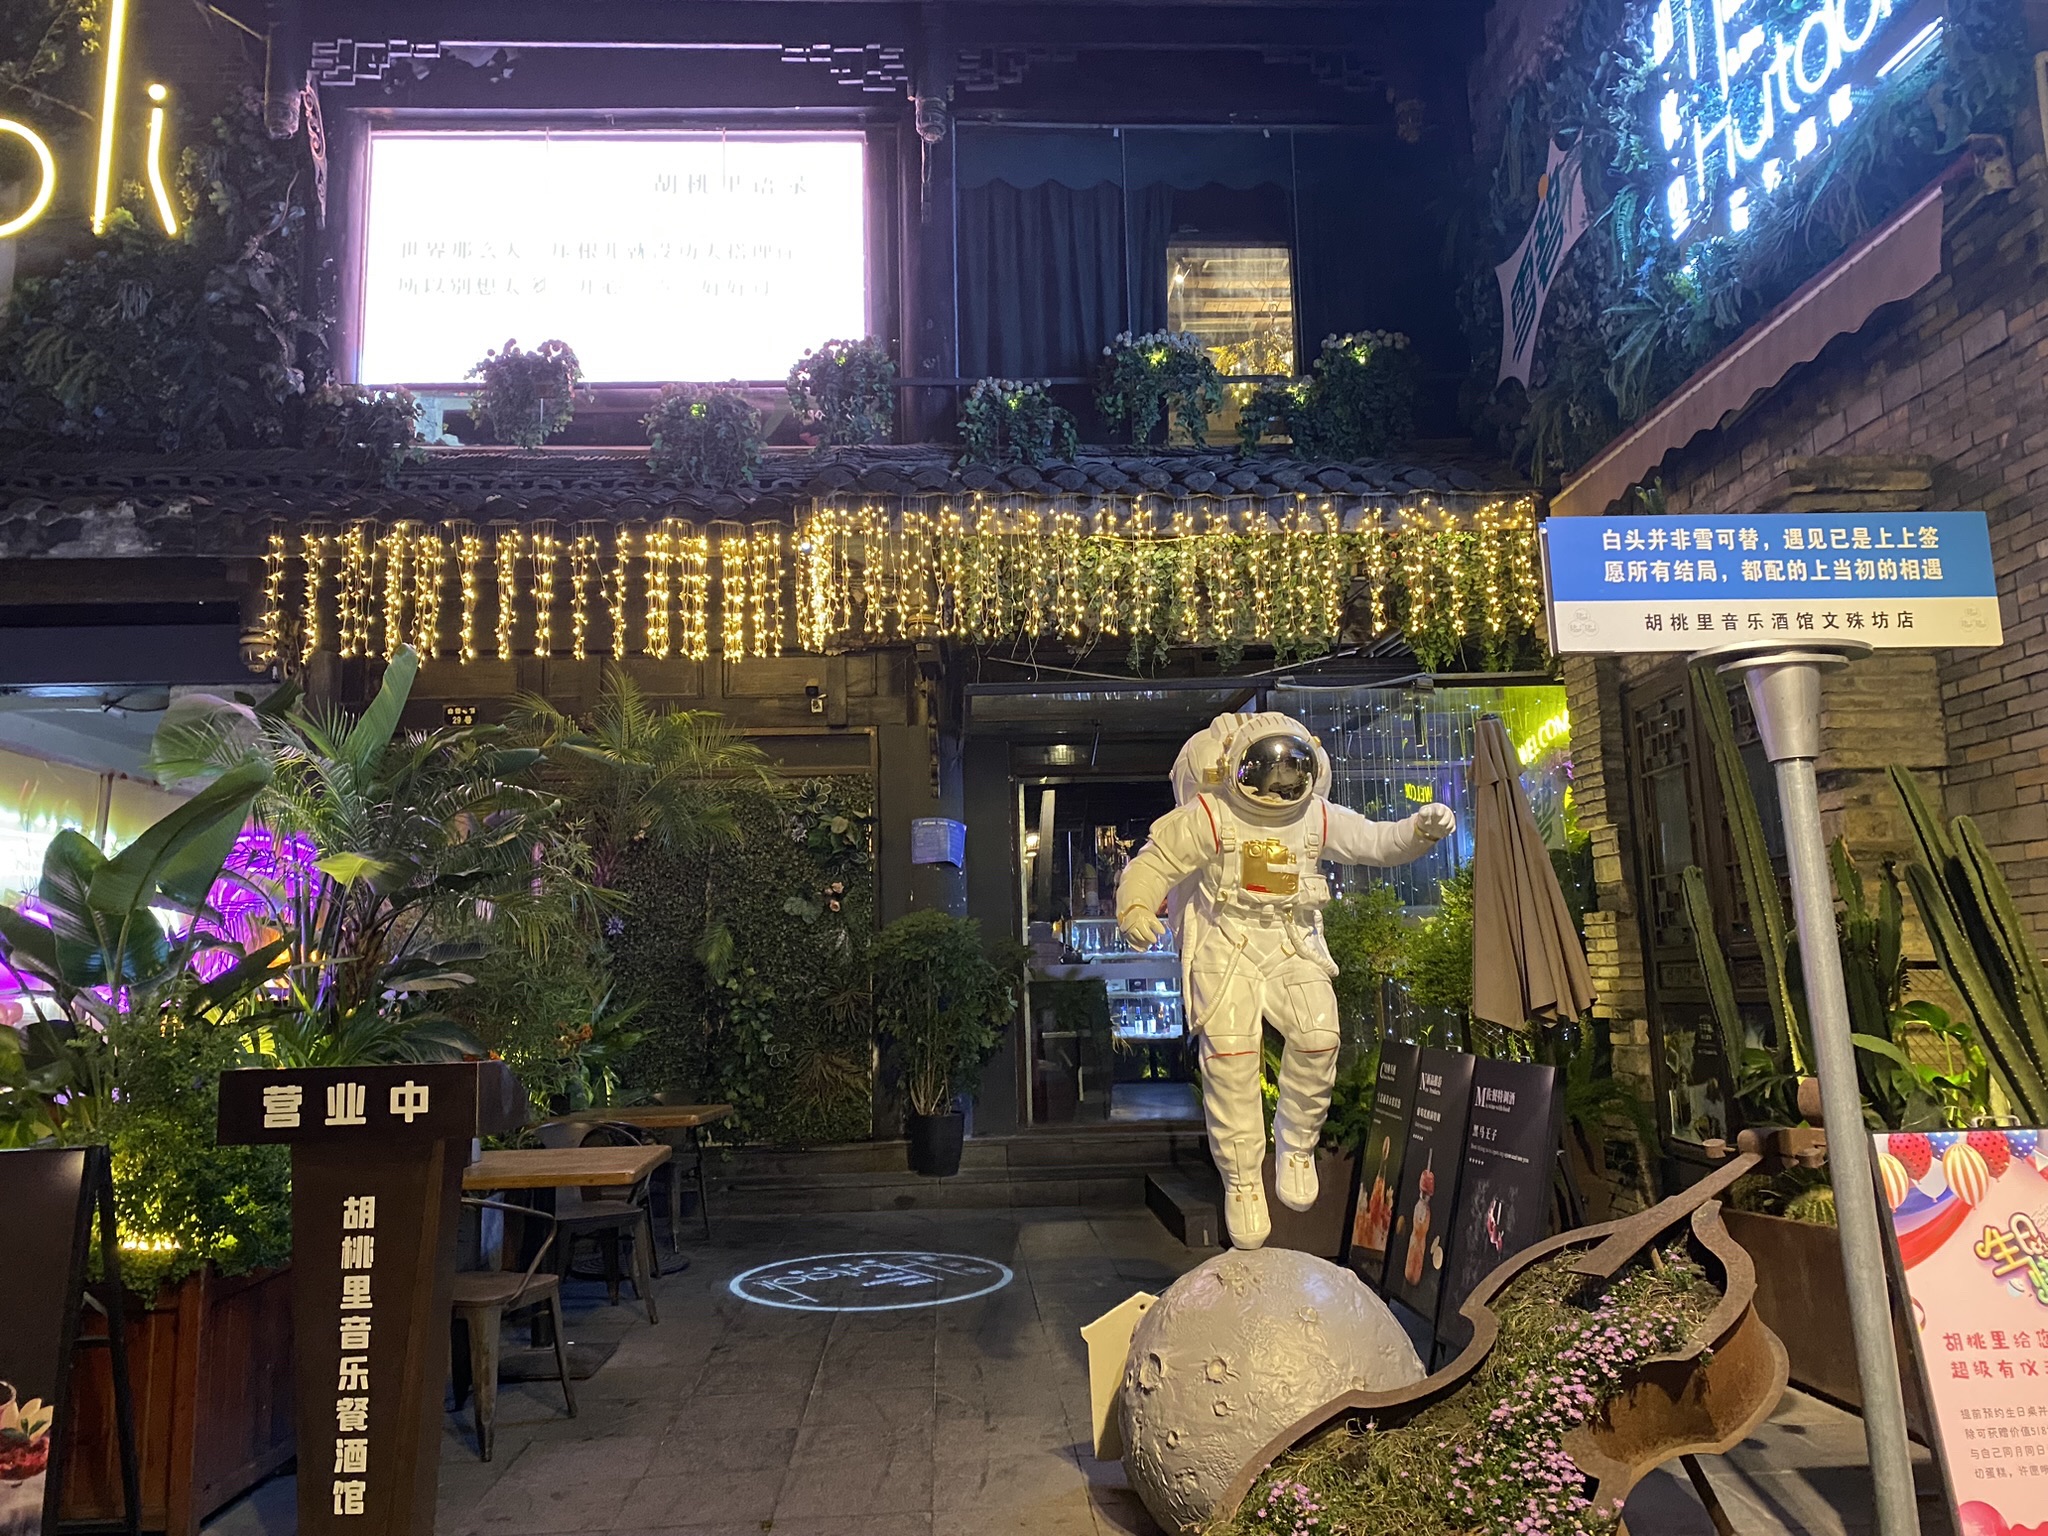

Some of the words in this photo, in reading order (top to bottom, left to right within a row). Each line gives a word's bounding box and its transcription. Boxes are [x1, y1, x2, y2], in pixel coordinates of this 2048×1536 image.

[1602, 526, 1940, 551] 白头并非雪可替，遇见已是上上签
[1604, 557, 1944, 583] 愿所有结局，都配的上当初的相遇
[1645, 611, 1915, 631] 胡桃里音乐酒馆文殊坊店
[262, 1080, 430, 1129] 营业中
[332, 1195, 376, 1516] 胡桃里音乐餐酒馆
[1964, 1426, 2048, 1440] 除可获赠价值518
